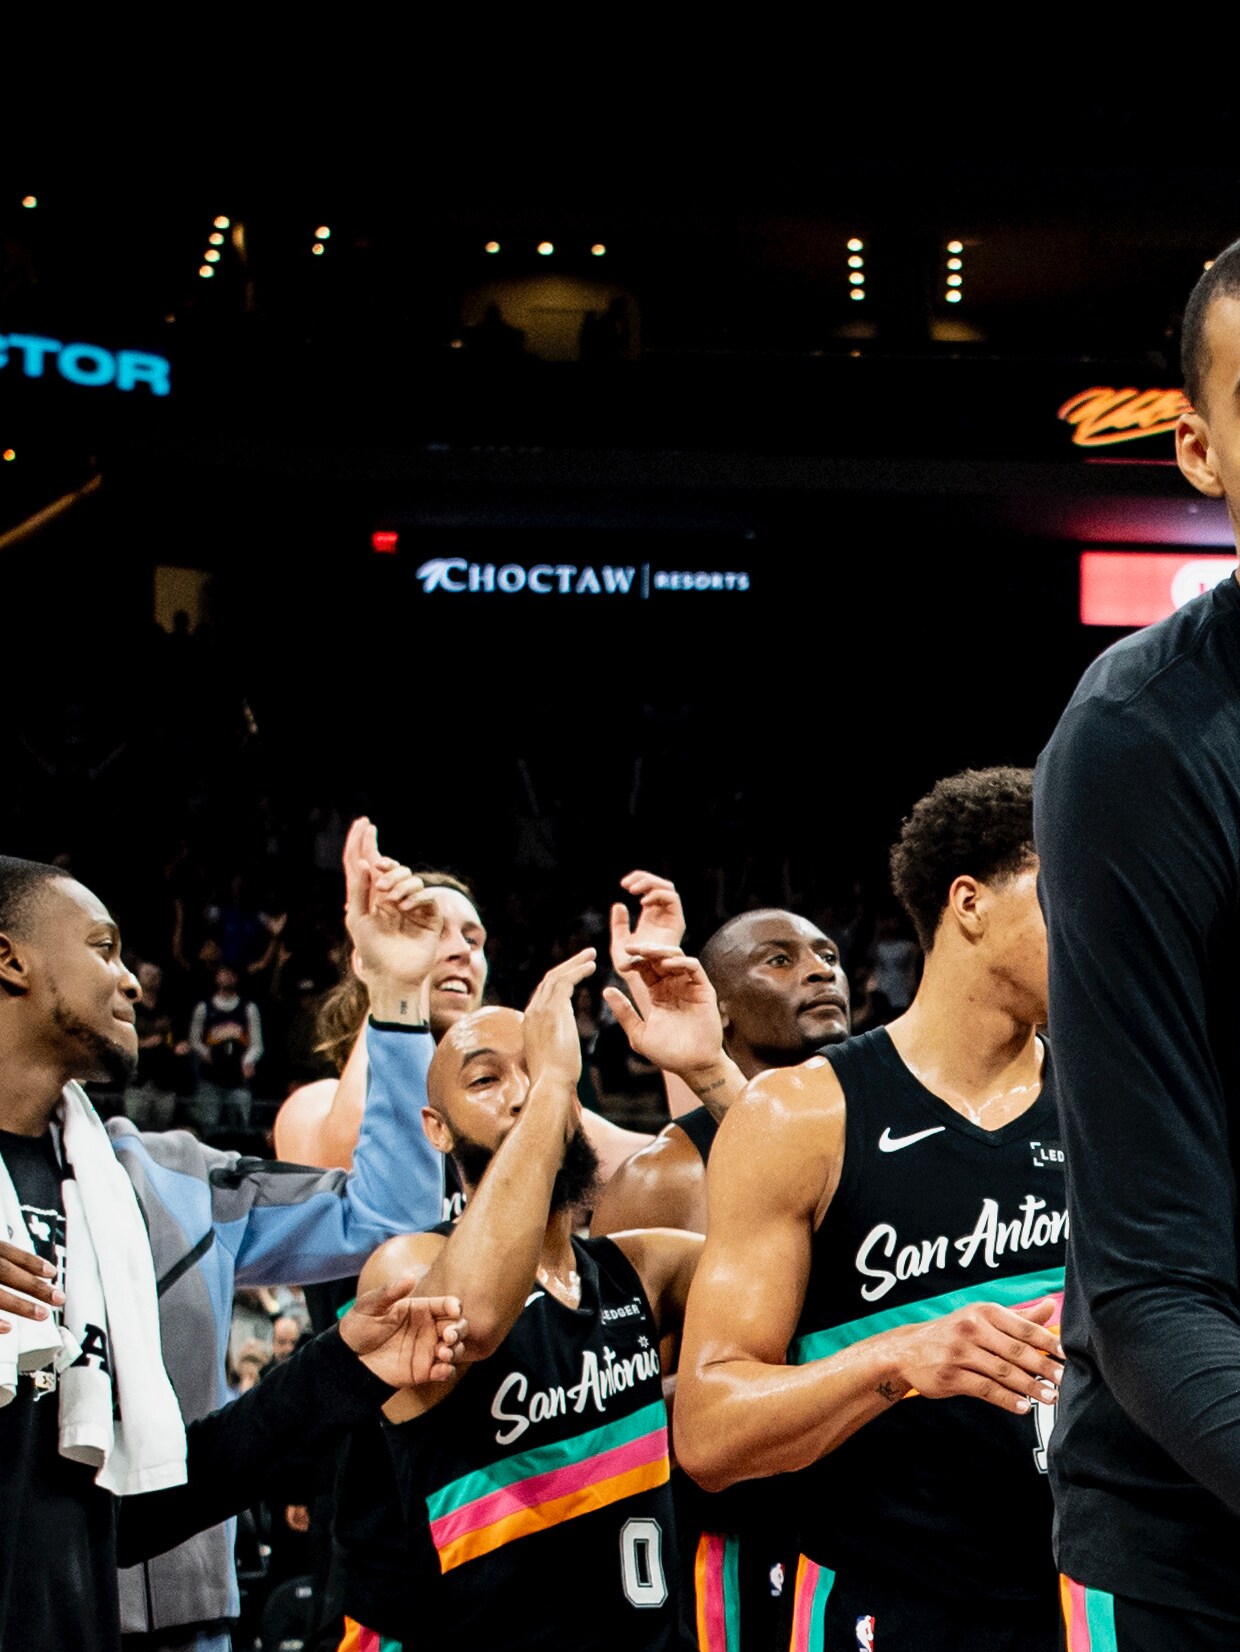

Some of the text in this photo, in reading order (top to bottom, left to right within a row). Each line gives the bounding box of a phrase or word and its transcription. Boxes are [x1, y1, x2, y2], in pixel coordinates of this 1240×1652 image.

[0, 333, 171, 396] TOR
[415, 557, 750, 594] CHOCTAW RESORTS
[1040, 1149, 1066, 1163] LED
[855, 1194, 1071, 1302] San Anton
[491, 1371, 567, 1446] San
[619, 1517, 668, 1608] 0
